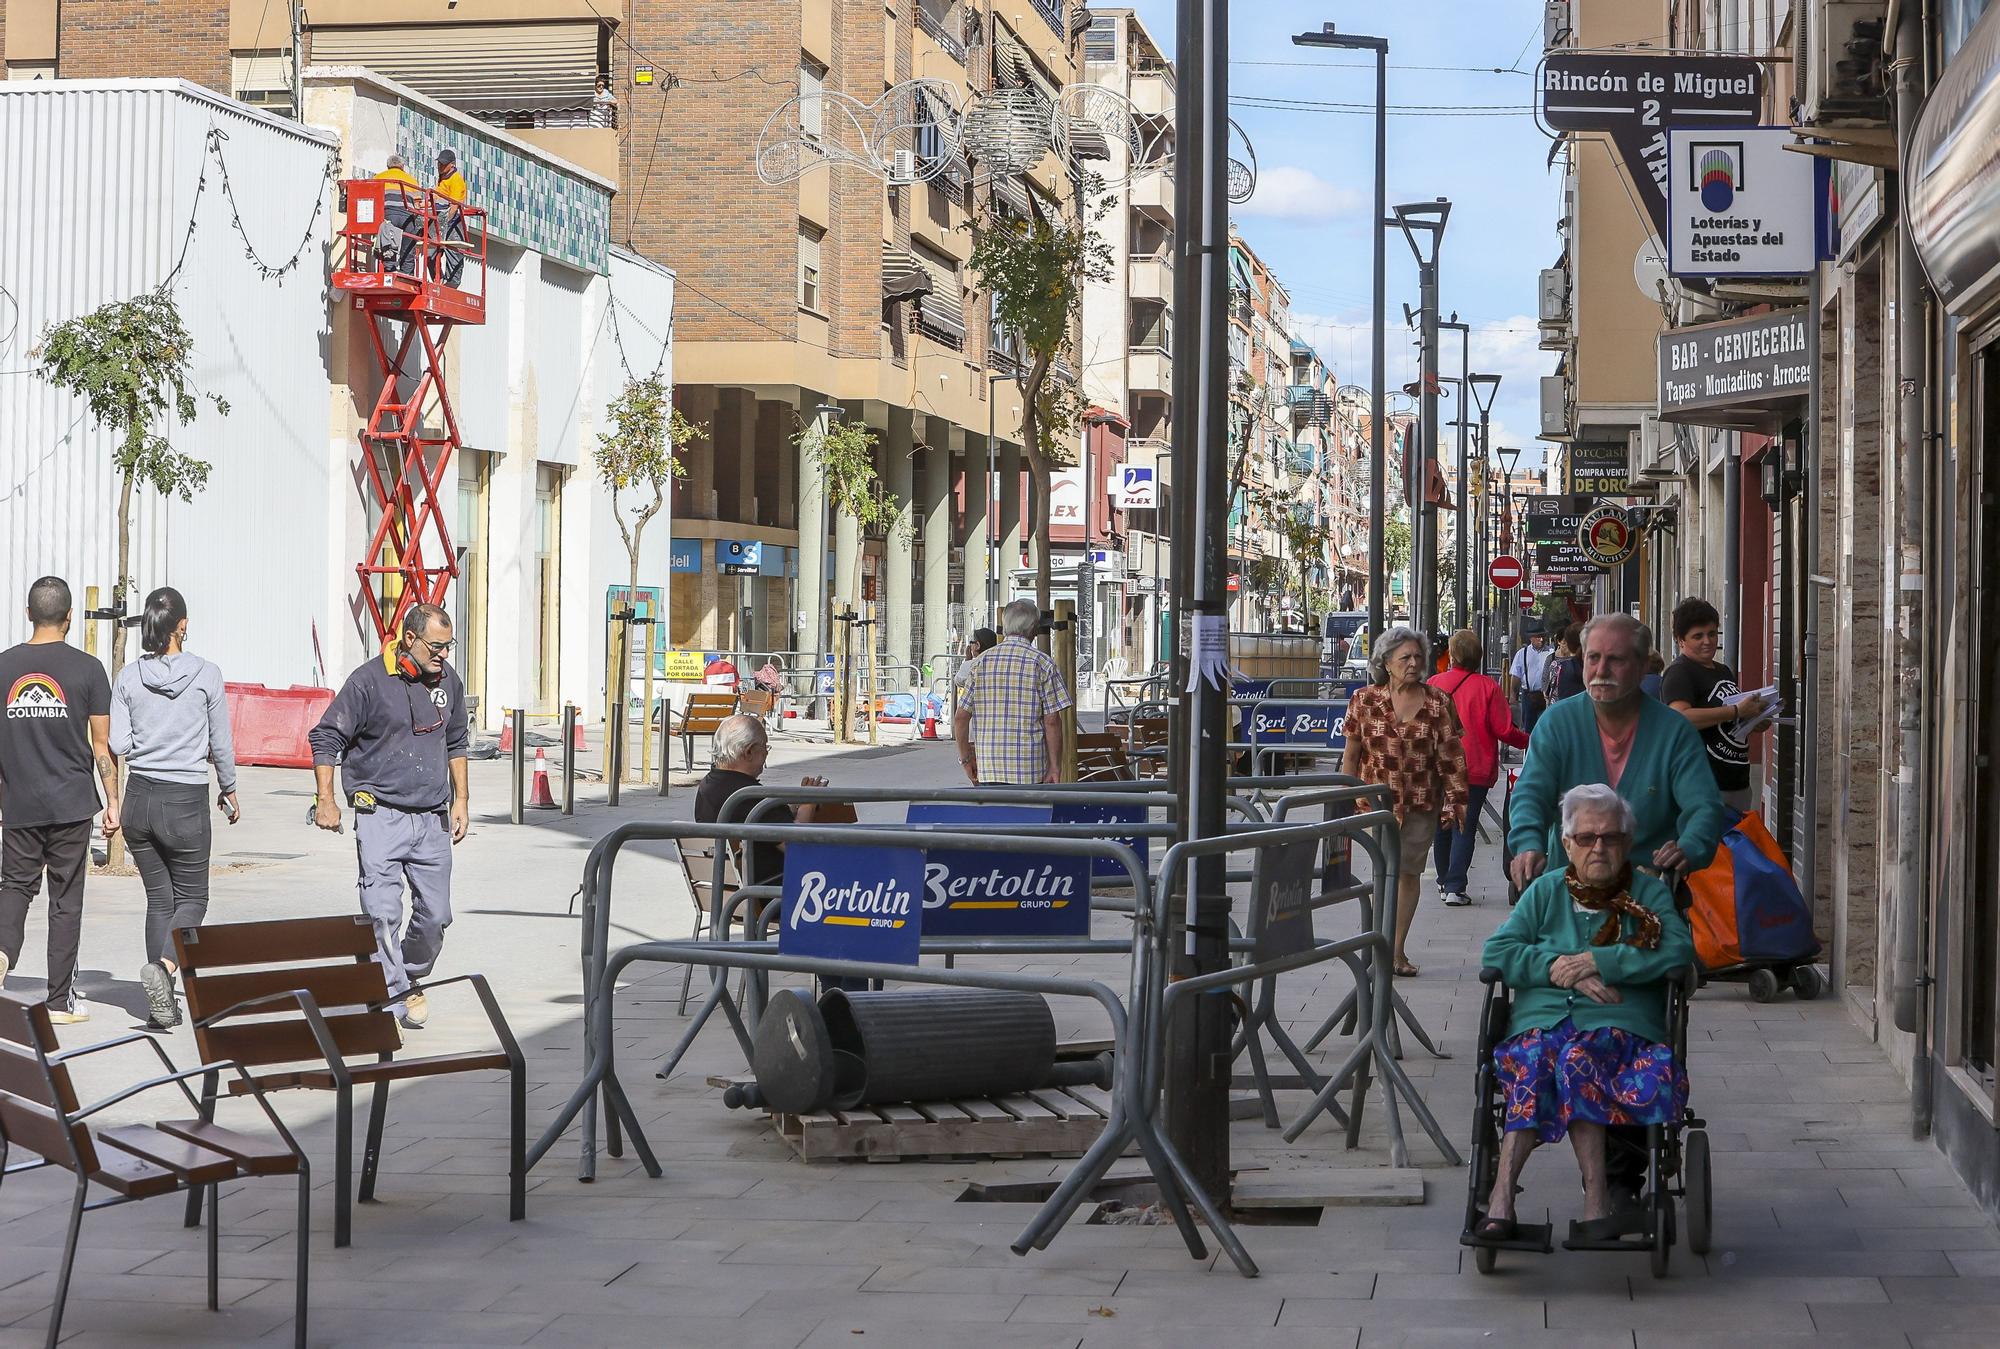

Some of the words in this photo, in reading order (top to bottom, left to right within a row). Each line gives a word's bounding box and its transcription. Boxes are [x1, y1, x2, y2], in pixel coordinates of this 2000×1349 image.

[1545, 69, 1628, 92] Rincón
[1637, 72, 1665, 93] de
[1674, 72, 1755, 99] Miguel
[1642, 99, 1661, 126] 2
[1690, 216, 1750, 230] Loterías
[1752, 217, 1762, 232] y
[1691, 232, 1759, 249] Apuestas
[1761, 232, 1784, 246] del
[1691, 249, 1741, 263] Estado
[1671, 341, 1699, 371] BAR
[1714, 314, 1806, 364] CERVECERÍA
[1665, 380, 1697, 405] Tapas
[1705, 369, 1764, 396] Montaditos
[1574, 468, 1605, 477] COMPRA
[1575, 478, 1594, 493] DE
[1124, 497, 1152, 505] FLEX
[1050, 505, 1079, 518] EX
[671, 554, 690, 568] dell
[433, 690, 446, 705] B
[6, 707, 69, 719] COLUMBIA
[1715, 742, 1737, 758] SAINT
[922, 862, 1075, 909] Bertolín
[790, 871, 910, 931] Bertolín
[1020, 900, 1051, 909] GRUPO
[870, 918, 893, 928] GRUPO
